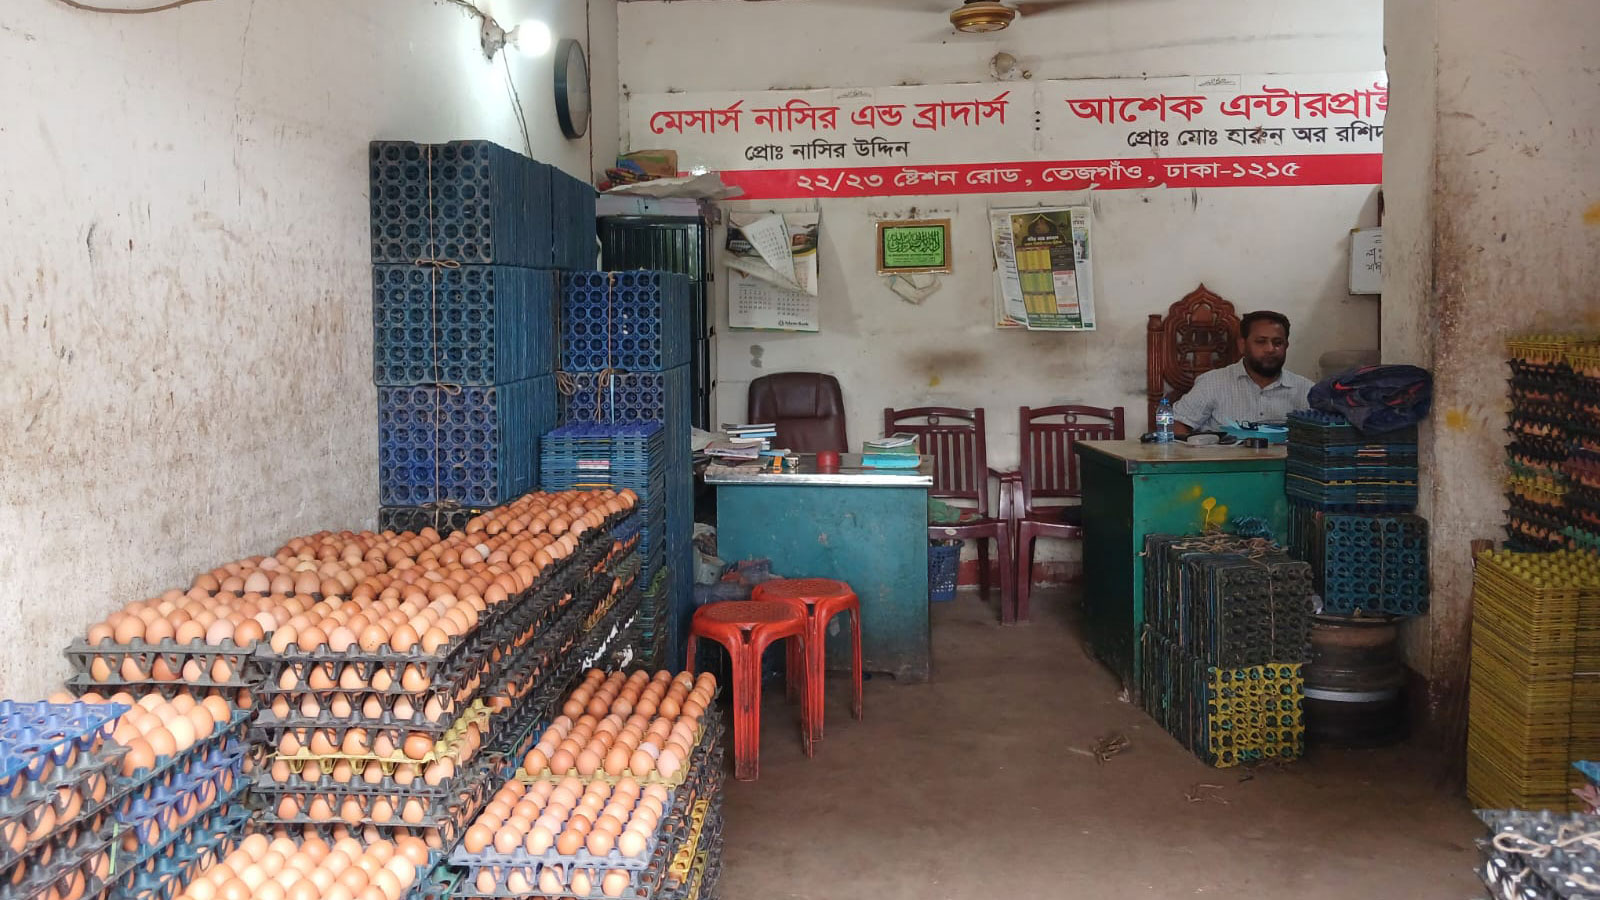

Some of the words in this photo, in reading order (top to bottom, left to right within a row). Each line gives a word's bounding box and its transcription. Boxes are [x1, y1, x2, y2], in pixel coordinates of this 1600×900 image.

[650, 99, 744, 134] মেসার্স
[751, 98, 841, 133] নাসির
[851, 104, 907, 129] এন্ড
[912, 91, 1010, 131] ব্রাদার্স
[1065, 94, 1207, 124] আশেক
[745, 144, 784, 161] প্রোঃ
[790, 138, 847, 160] নাসির
[853, 137, 911, 158] উদ্দিন
[1127, 129, 1169, 148] প্রোঃ
[1177, 128, 1218, 146] মোঃ
[1291, 127, 1329, 143] অর
[797, 171, 884, 192] ২২/২৩
[1163, 162, 1300, 180] ঢাকা-১২১৫
